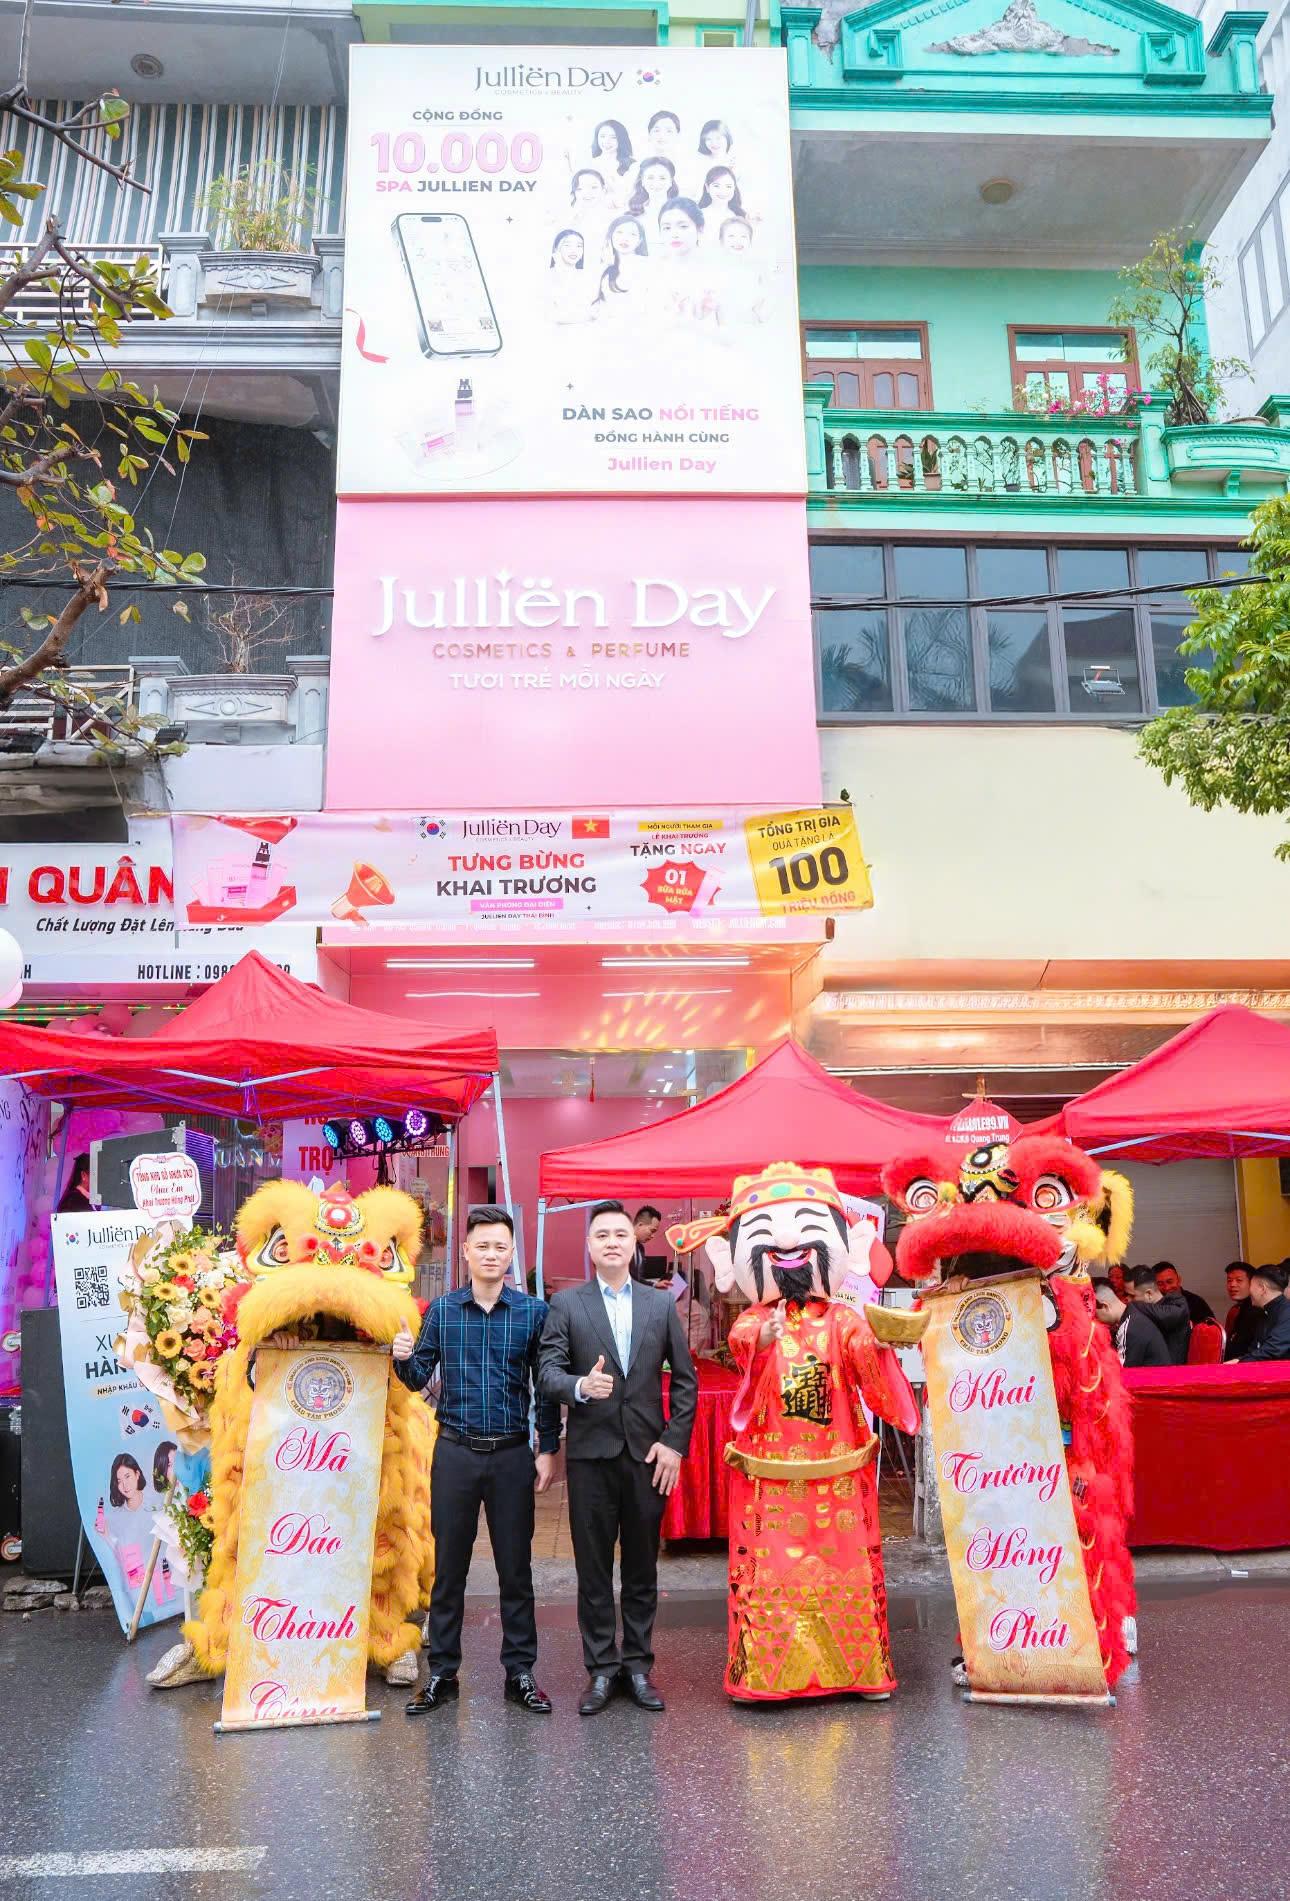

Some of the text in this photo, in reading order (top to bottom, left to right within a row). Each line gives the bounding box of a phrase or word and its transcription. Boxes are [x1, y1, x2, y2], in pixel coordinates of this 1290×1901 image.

[567, 67, 622, 92] Day
[412, 107, 503, 124] CỘNG ĐỒNG
[370, 131, 544, 174] 10.000
[375, 180, 537, 193] SPA JULLIEN DAY
[562, 404, 606, 421] DÀN
[611, 407, 653, 422] SAO
[700, 402, 759, 422] TIẾNG
[594, 429, 730, 443] ĐỒNG HÀNH CÙNG
[607, 457, 717, 474] Jullien Day
[631, 575, 777, 639] Day
[432, 642, 690, 659] COSMETICS & PERFUME
[559, 663, 600, 690] MỖI
[606, 667, 666, 690] NGÀY
[524, 819, 562, 838] Day
[757, 820, 793, 839] TỔNG
[795, 818, 817, 833] TRỊ
[448, 850, 585, 872] TƯNG BỪNG
[630, 842, 727, 859] TẶNG NGAY
[665, 868, 687, 886] 01
[769, 846, 849, 896] 100
[436, 875, 597, 896] KHAI TRƯƠNG
[36, 917, 69, 932] Chất
[72, 918, 115, 934] Lượng
[120, 917, 147, 934] Đặt
[150, 918, 175, 932] Lên
[137, 964, 192, 980] HOTLINE
[135, 1225, 155, 1241] Da
[949, 1368, 1037, 1413] Khai
[275, 1426, 353, 1473] Mã
[940, 1451, 1063, 1503] Trương
[242, 1594, 357, 1643] Thành
[989, 1607, 1070, 1651] Phát
